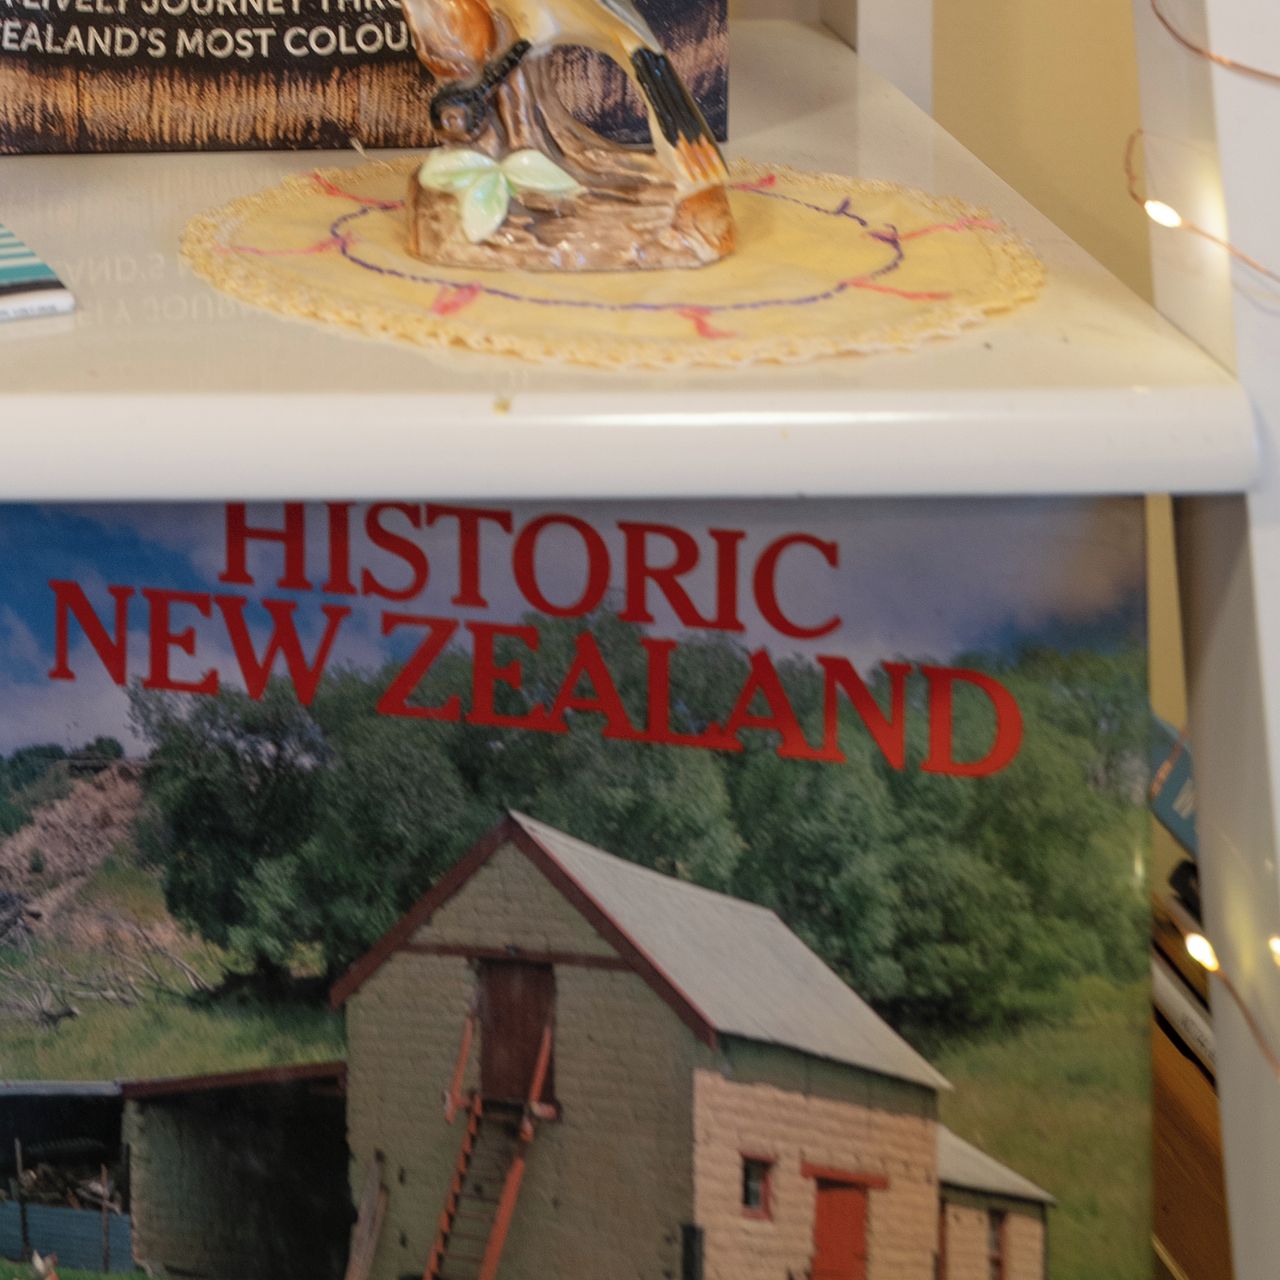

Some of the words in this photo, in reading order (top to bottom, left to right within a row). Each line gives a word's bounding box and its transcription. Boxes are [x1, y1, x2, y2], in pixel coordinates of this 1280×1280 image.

[175, 23, 277, 60] MOST
[283, 20, 418, 58] COLOU
[218, 501, 845, 640] HISTORIC
[46, 577, 351, 708] NEW
[375, 608, 1025, 779] ZEALAND
